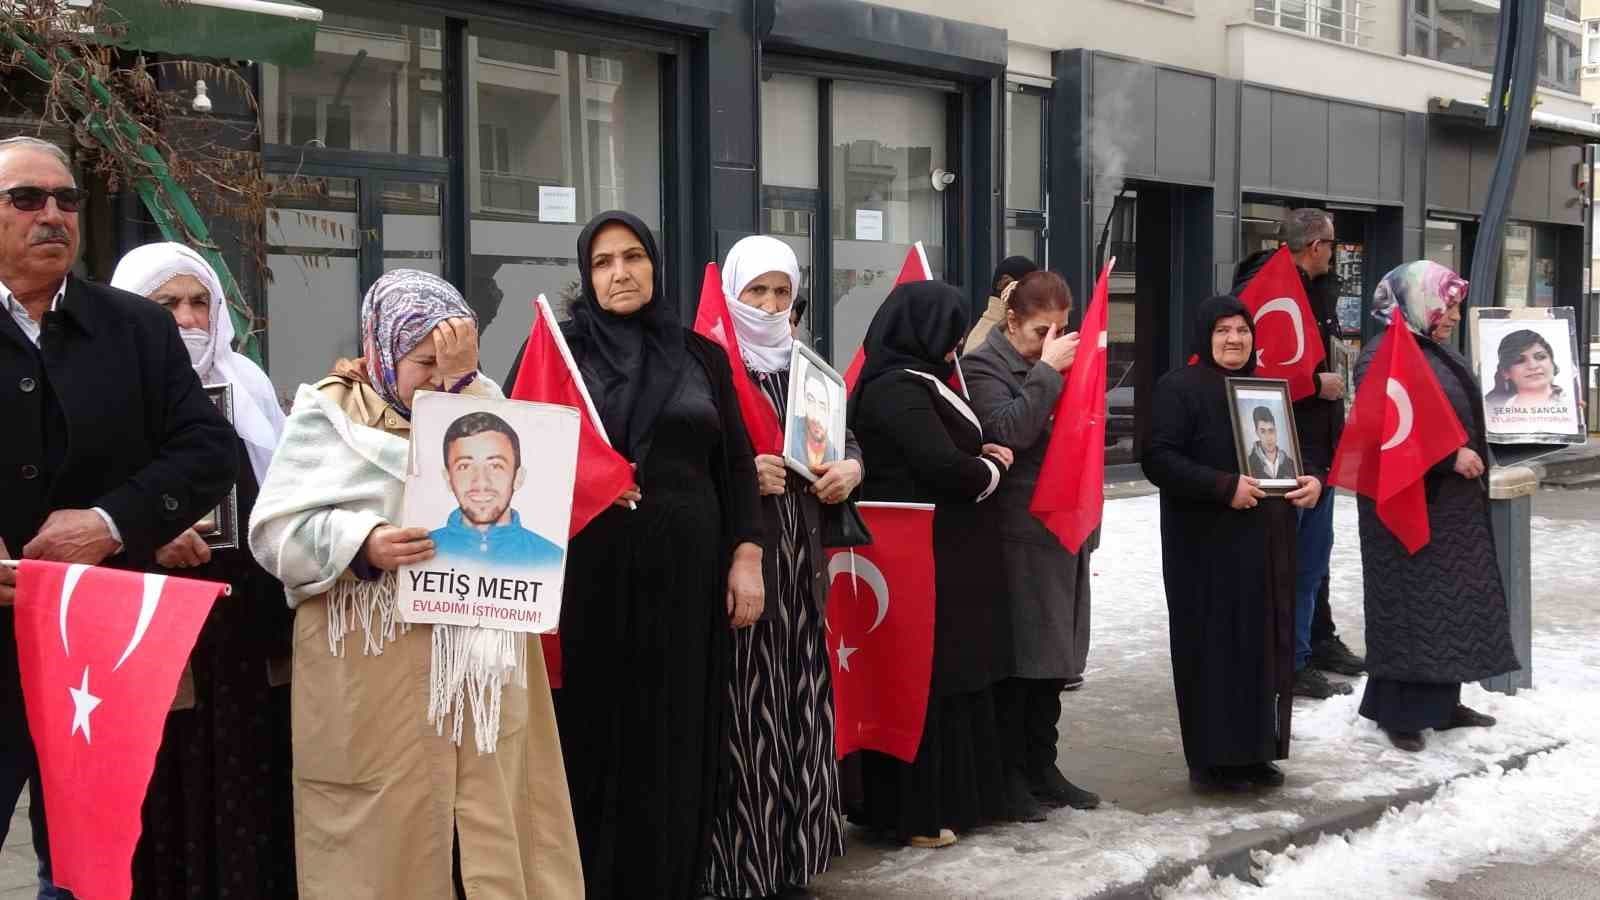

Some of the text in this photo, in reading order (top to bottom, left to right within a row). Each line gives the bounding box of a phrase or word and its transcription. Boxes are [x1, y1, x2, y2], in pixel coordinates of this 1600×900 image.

[409, 568, 543, 602] YETİŞ MERT
[412, 600, 542, 623] EVLADIMI İSTİYORUM!
